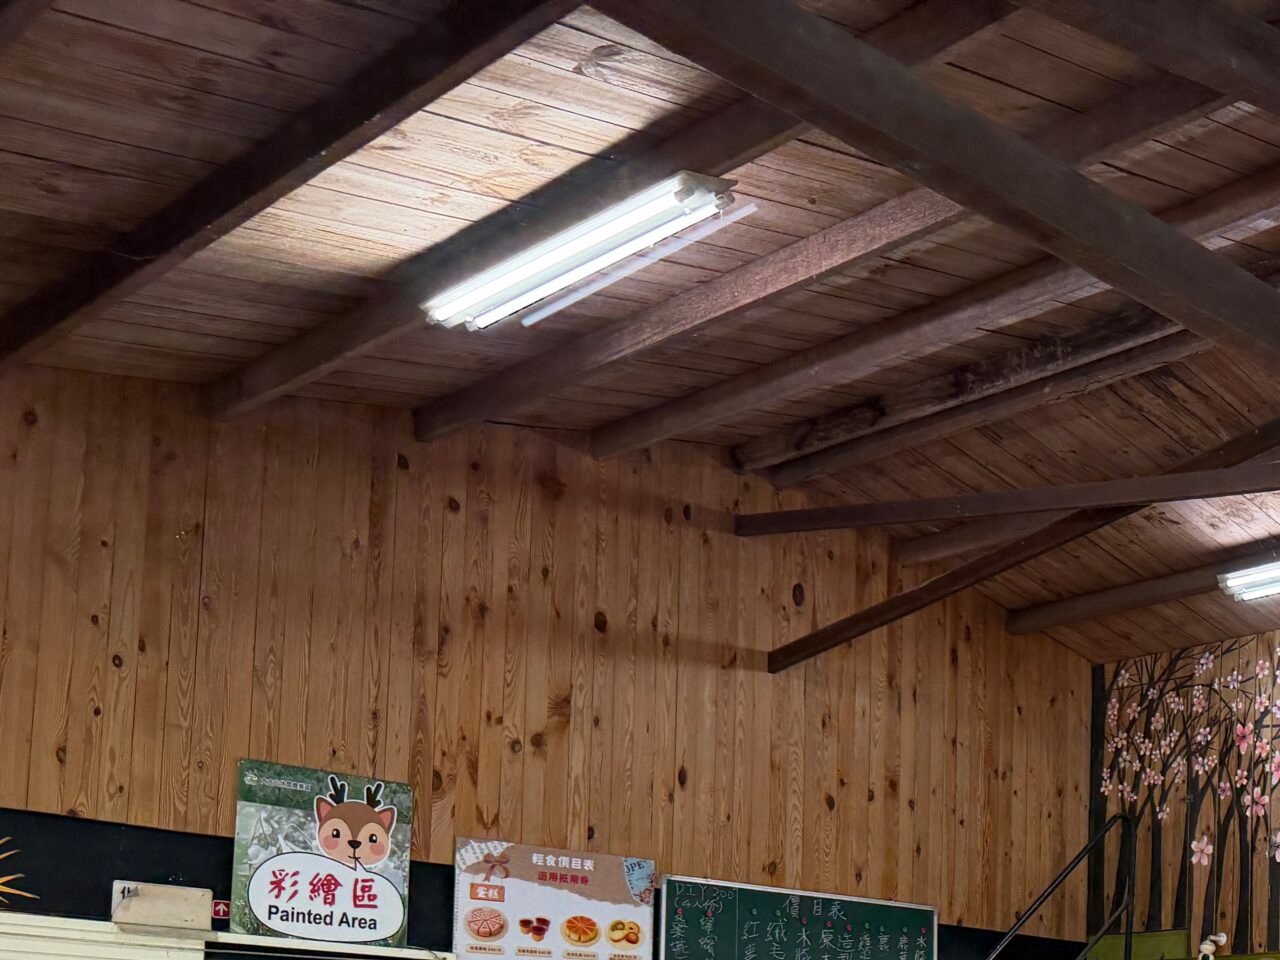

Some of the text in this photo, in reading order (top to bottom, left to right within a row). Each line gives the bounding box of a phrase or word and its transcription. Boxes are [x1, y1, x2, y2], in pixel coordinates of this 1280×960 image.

[532, 853, 595, 871] 輕食價目表
[268, 868, 378, 909] 彩繪區
[676, 883, 708, 901] DIY
[267, 904, 378, 930] Painted Area
[783, 895, 847, 920] 價目表
